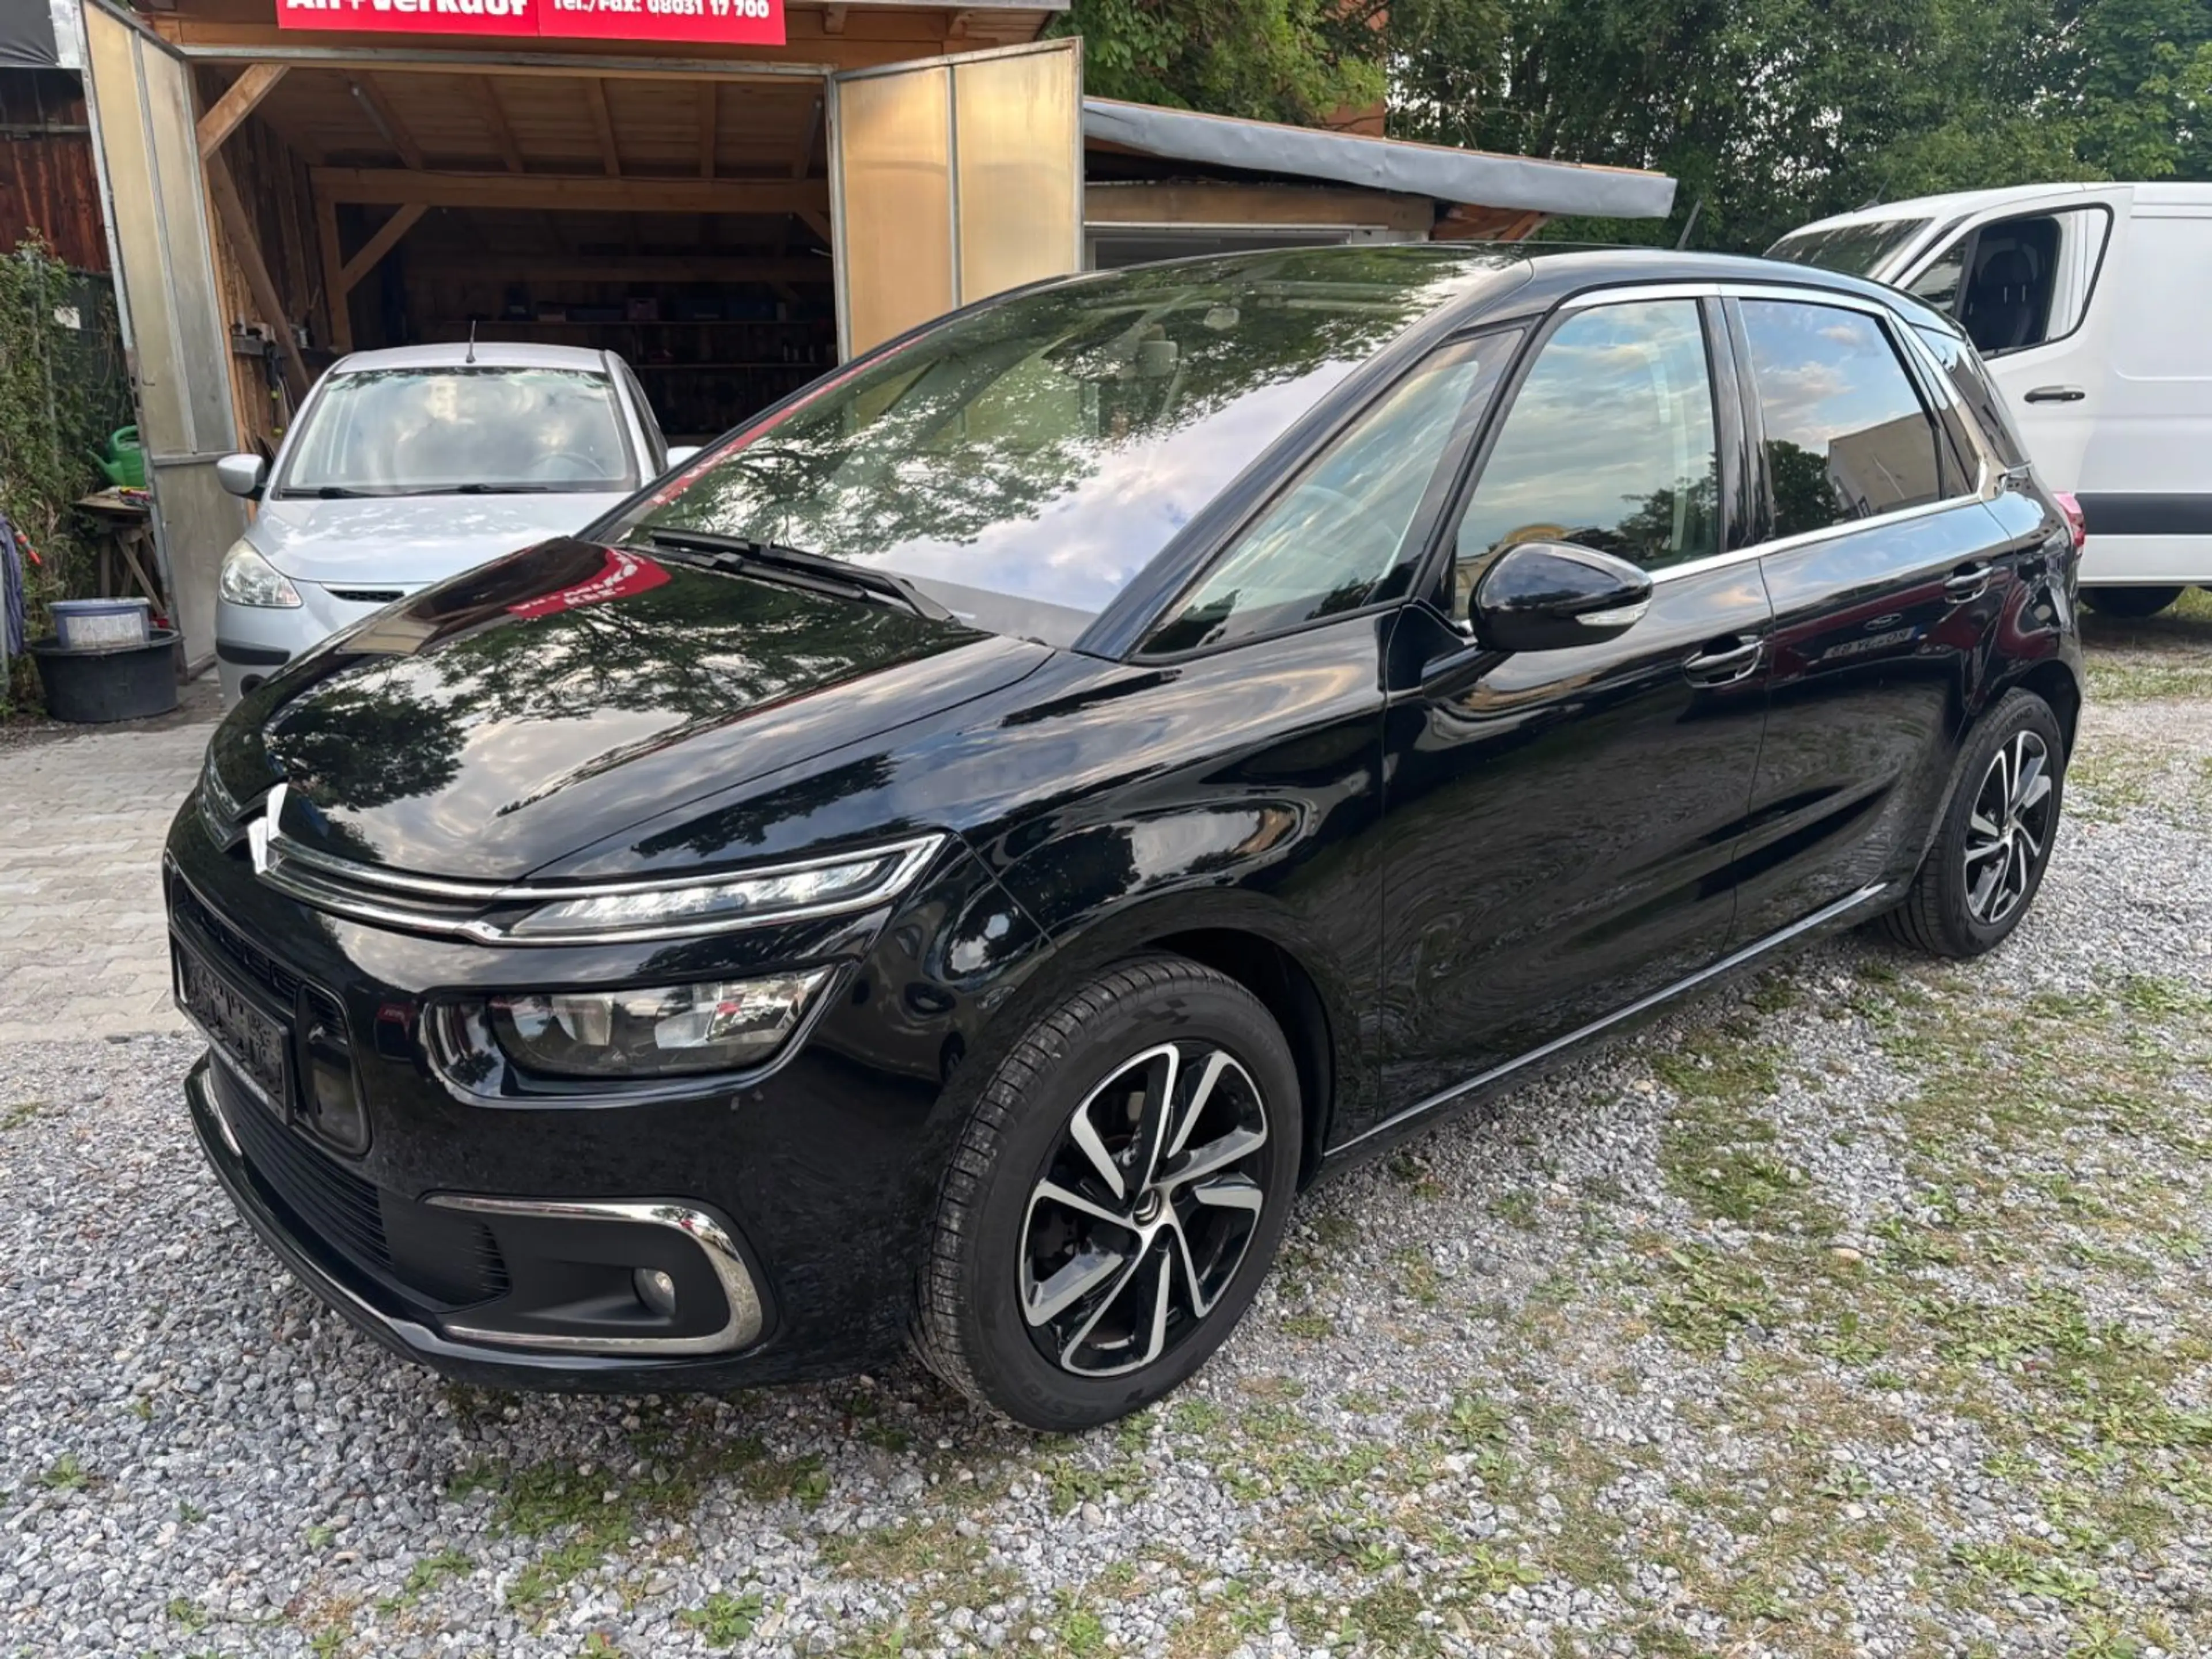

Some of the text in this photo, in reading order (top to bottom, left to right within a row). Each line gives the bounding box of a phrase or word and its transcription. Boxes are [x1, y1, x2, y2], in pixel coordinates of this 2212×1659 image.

[647, 0, 704, 15] 08031
[709, 0, 730, 16] 17
[733, 0, 770, 18] 700
